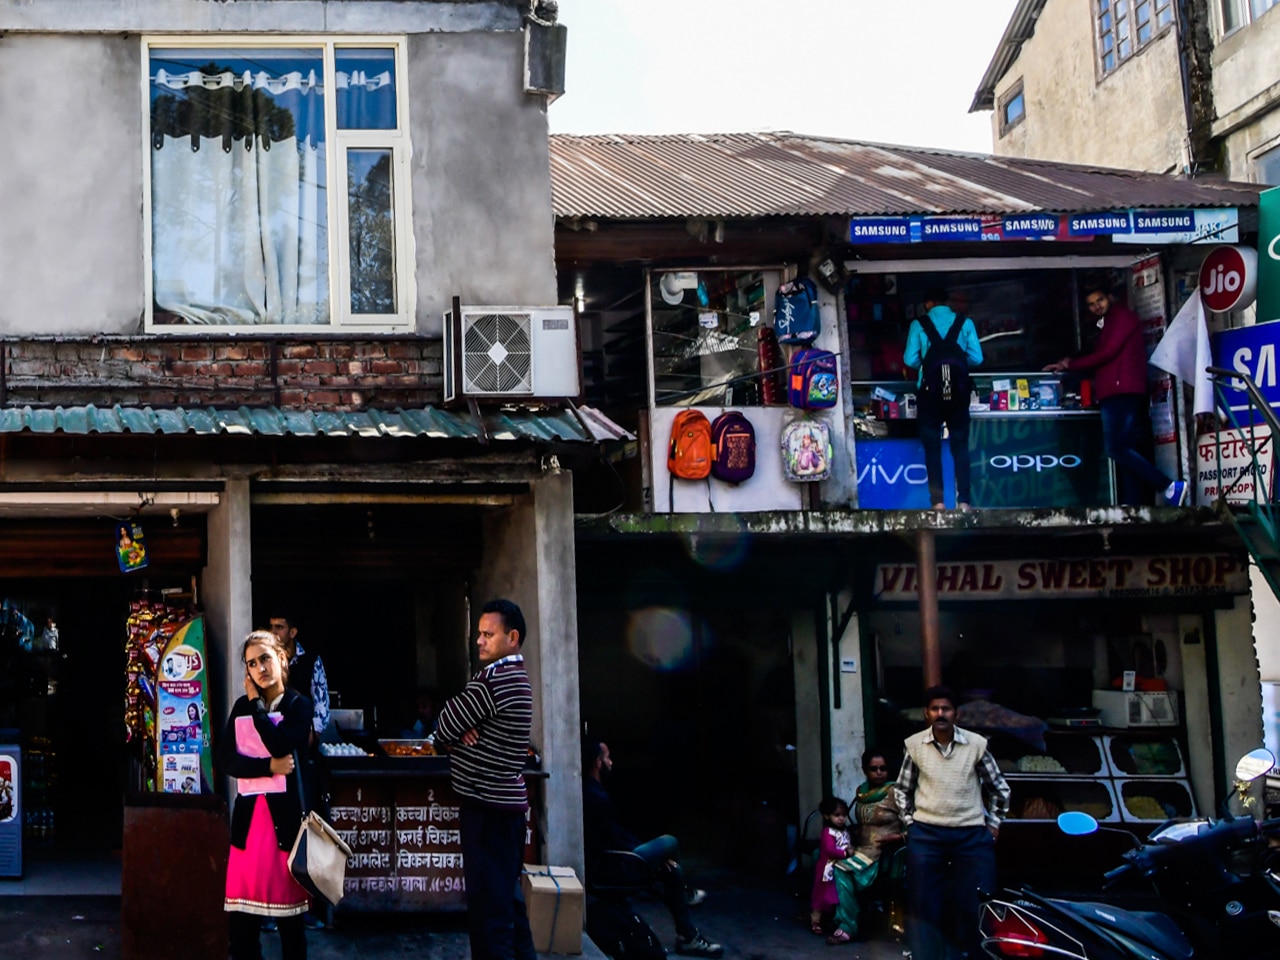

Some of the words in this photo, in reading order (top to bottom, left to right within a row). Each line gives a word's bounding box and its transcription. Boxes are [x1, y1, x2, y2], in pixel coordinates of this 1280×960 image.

[924, 222, 980, 235] SAMSUNG
[1005, 218, 1055, 232] SAMSUNG
[1072, 217, 1128, 231] SAMSUNG
[1137, 215, 1192, 229] SAMSUNG
[853, 224, 908, 237] SAMSUNG
[1203, 264, 1241, 296] Jio
[989, 453, 1082, 473] oppo
[857, 456, 929, 486] vivo
[879, 565, 1002, 592] VIHAL
[1017, 557, 1132, 590] SWEET
[1146, 555, 1236, 586] SHOP
